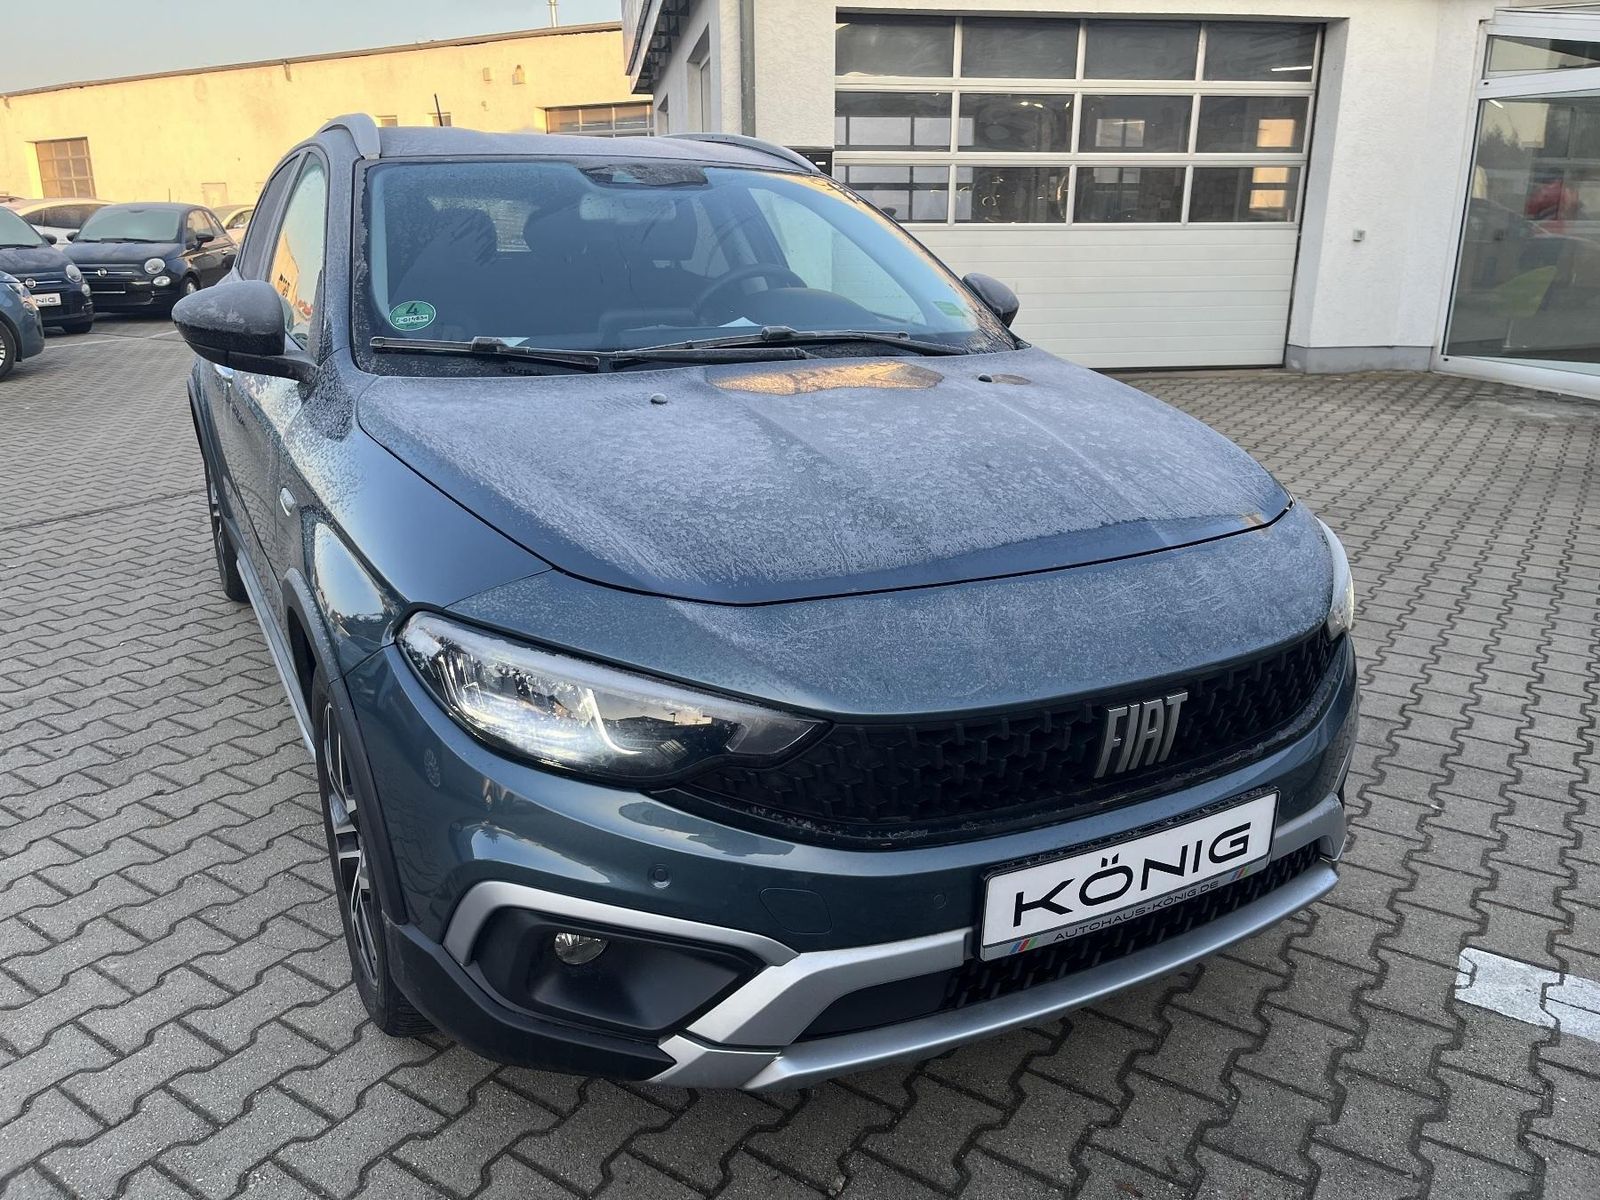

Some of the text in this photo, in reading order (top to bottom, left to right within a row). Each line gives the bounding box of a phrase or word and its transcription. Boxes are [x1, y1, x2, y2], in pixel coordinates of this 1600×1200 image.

[406, 302, 418, 315] 4
[1093, 692, 1188, 779] FIAT
[1013, 822, 1251, 927] KÖNIG
[1053, 880, 1219, 942] AUTOHAUS-KÖNIG.DE
